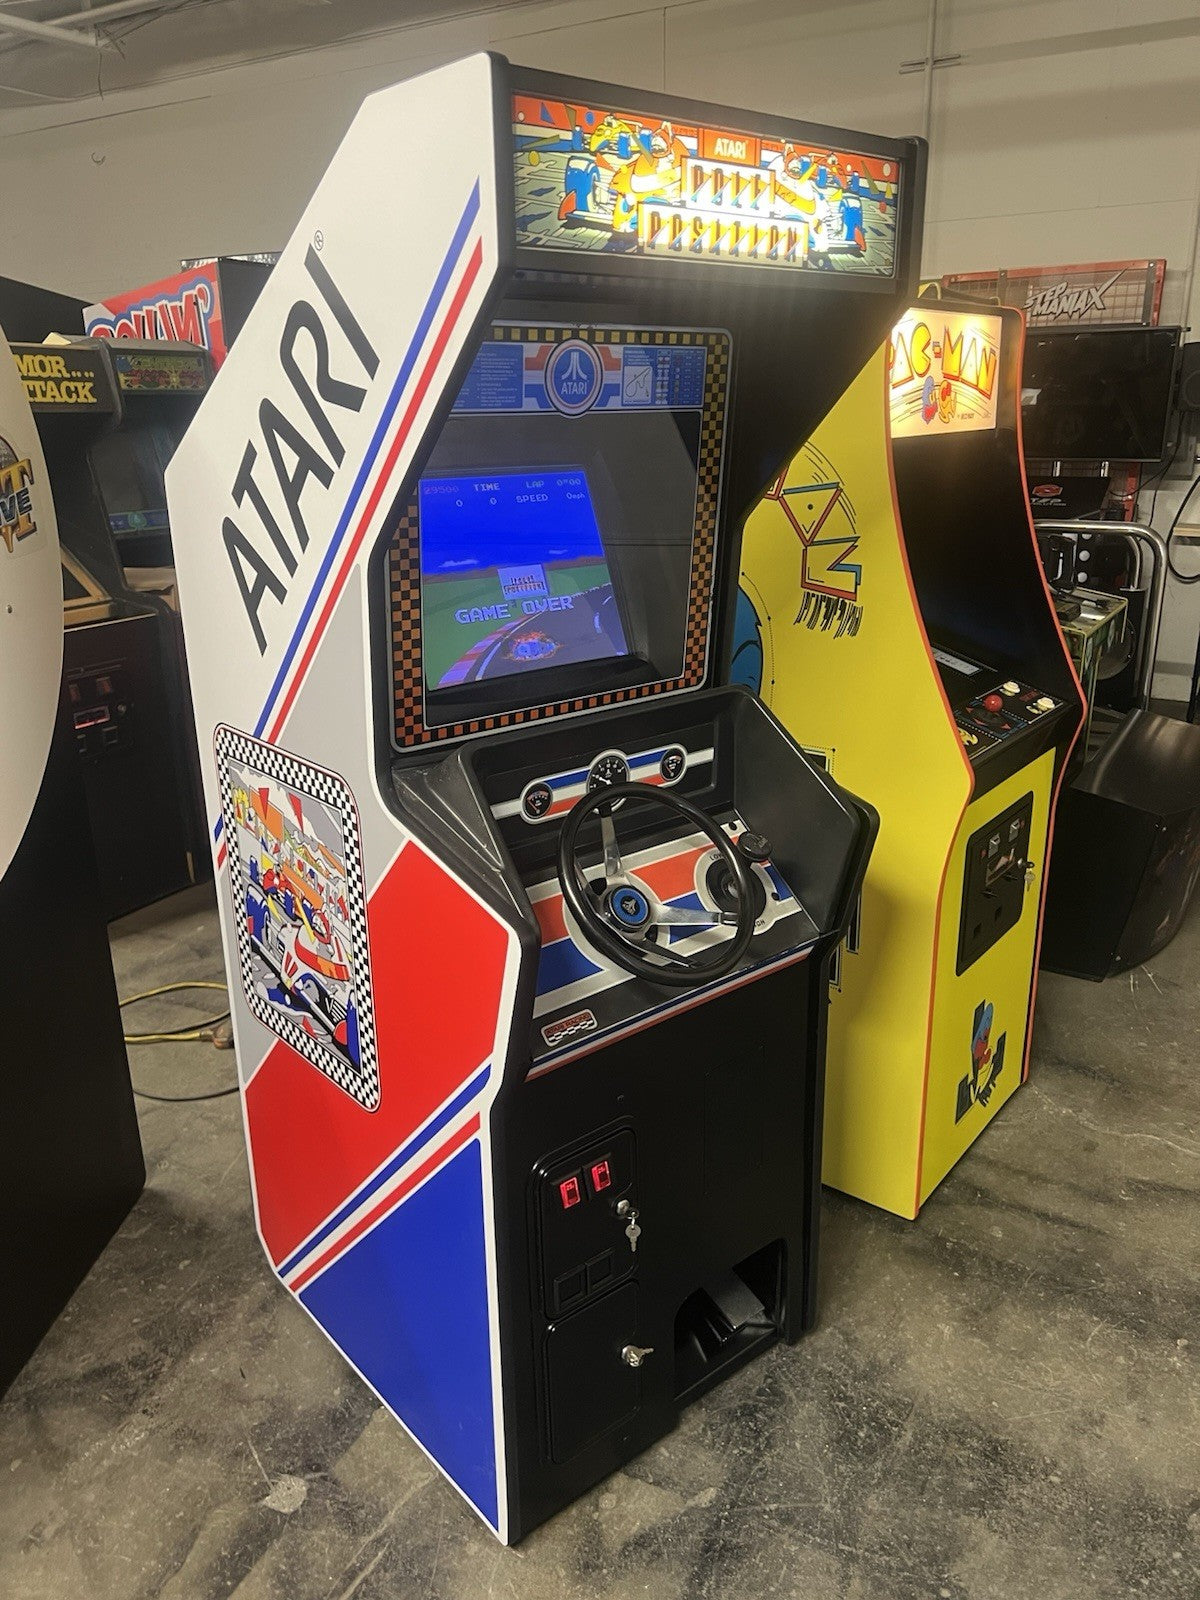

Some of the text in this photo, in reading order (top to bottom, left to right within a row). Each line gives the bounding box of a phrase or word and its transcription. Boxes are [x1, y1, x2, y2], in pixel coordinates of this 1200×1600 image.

[714, 137, 746, 160] ATARI
[691, 165, 765, 211] POLE
[647, 210, 801, 263] POSITION
[1021, 281, 1068, 310] STEP
[1031, 268, 1127, 321] MANIAX
[22, 380, 98, 404] TTACK
[561, 381, 588, 395] ATARI
[473, 483, 501, 492] TIME
[526, 480, 545, 489] LAP
[516, 493, 549, 503] SPEED
[454, 596, 575, 625] GAME OVER
